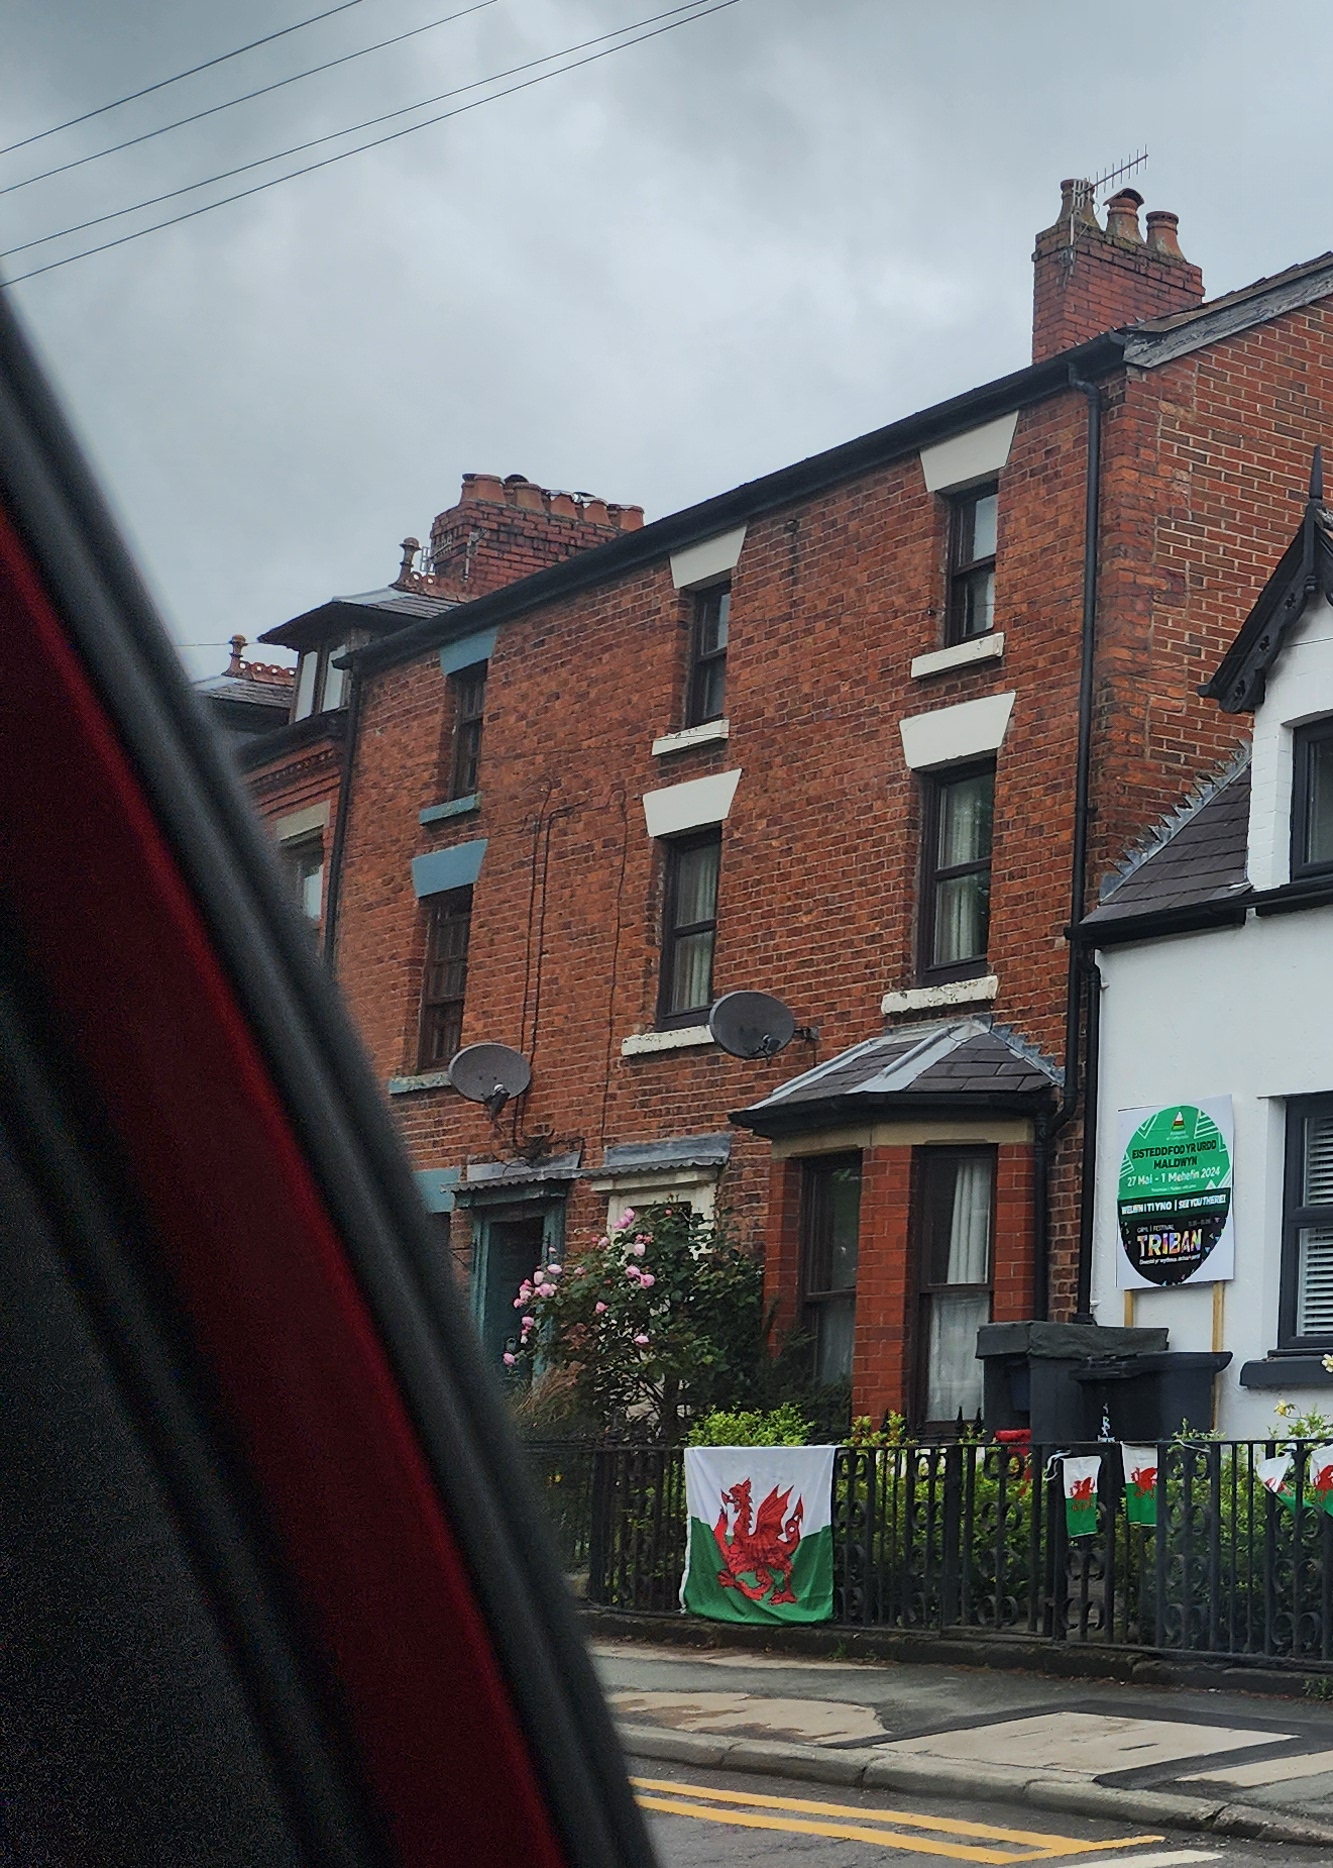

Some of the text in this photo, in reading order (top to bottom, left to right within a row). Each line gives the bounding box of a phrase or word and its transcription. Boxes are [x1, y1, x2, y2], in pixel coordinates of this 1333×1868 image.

[1132, 1141, 1217, 1159] EISTEDDFOD YR URDD
[1153, 1157, 1198, 1169] MALDWYN
[1127, 1177, 1136, 1187] 27
[1137, 1174, 1153, 1185] Mai
[1160, 1173, 1166, 1183] 1
[1168, 1169, 1200, 1183] Mehefin
[1200, 1167, 1220, 1178] 2024
[1137, 1229, 1203, 1257] TRIBAN
